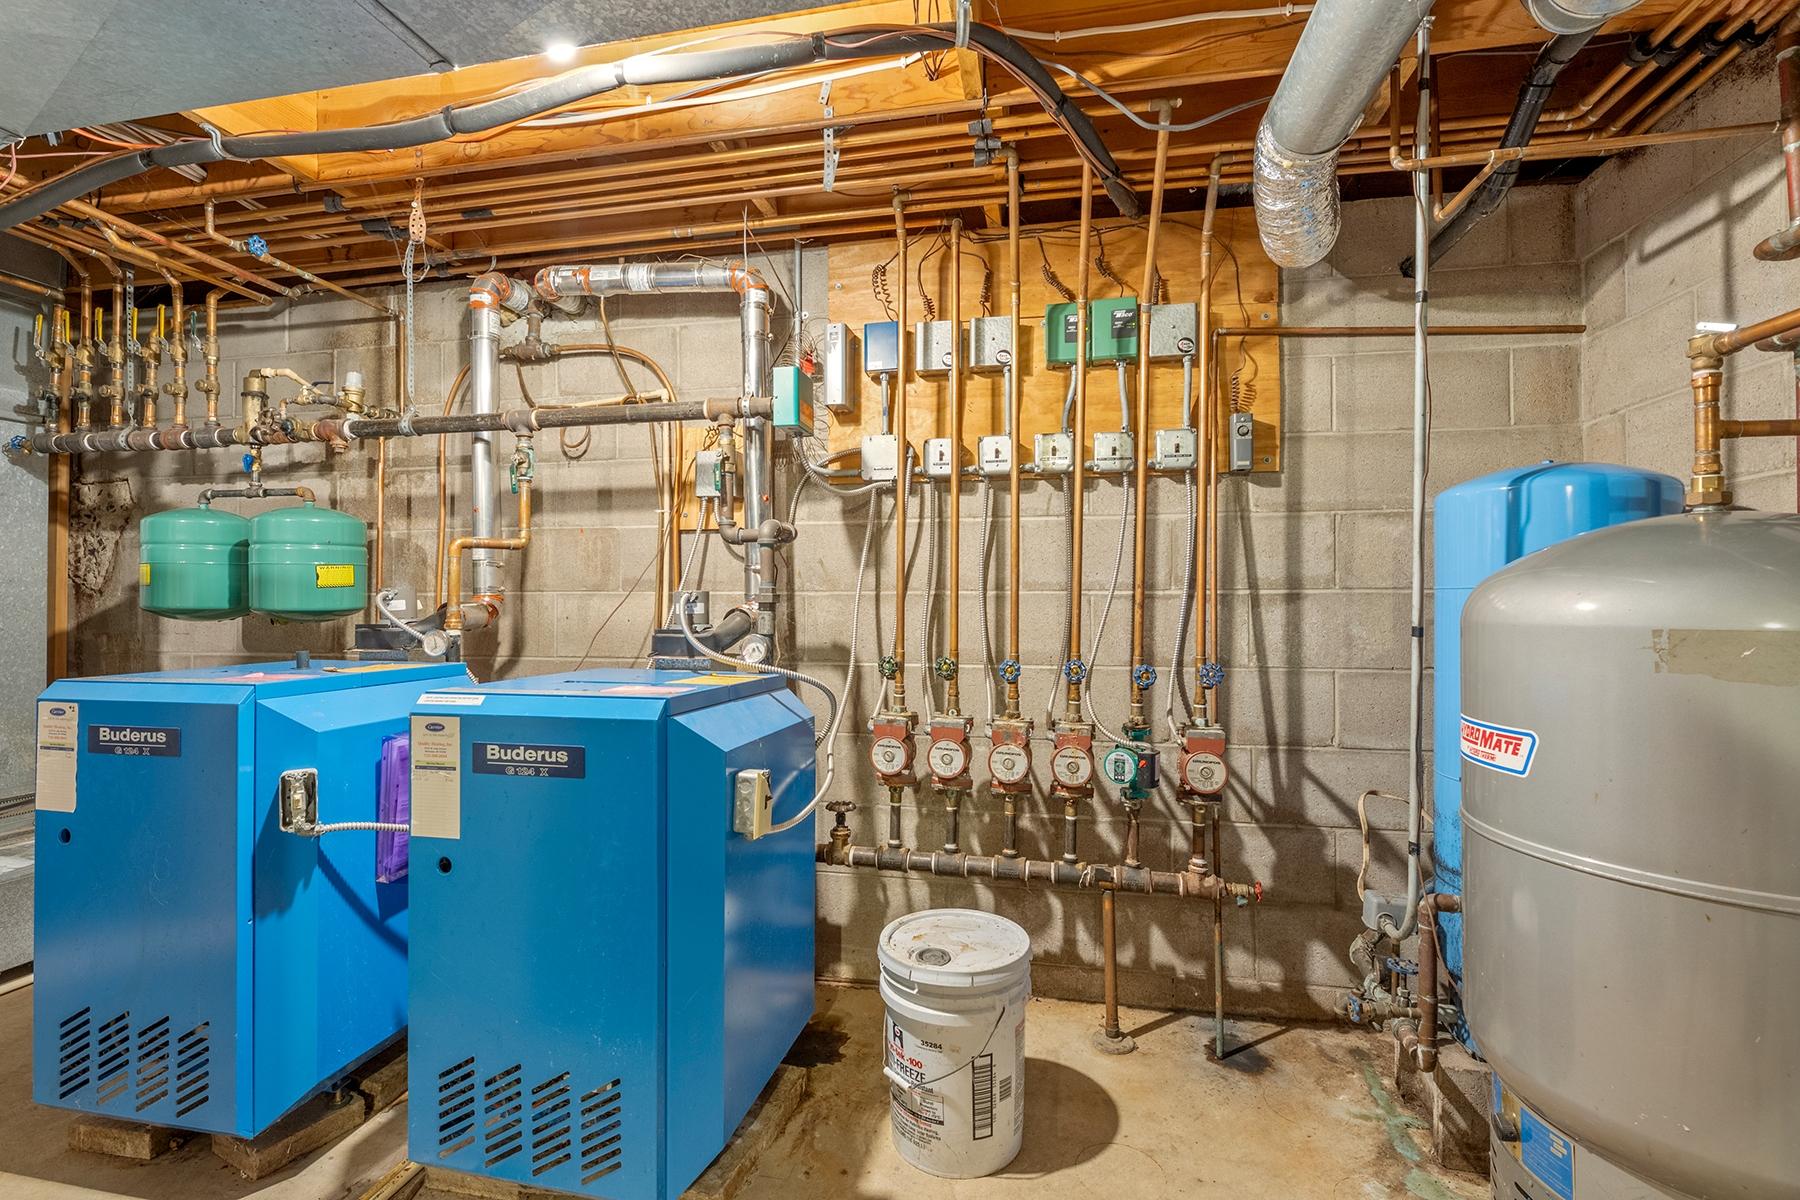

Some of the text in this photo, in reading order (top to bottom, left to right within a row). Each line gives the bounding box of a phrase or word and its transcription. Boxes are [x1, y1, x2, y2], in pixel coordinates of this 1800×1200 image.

[99, 727, 167, 743] Buderus
[142, 747, 150, 756] X
[486, 744, 569, 763] Buderus
[515, 767, 535, 776] 124
[539, 767, 549, 777] X
[920, 1039, 943, 1050] 35284
